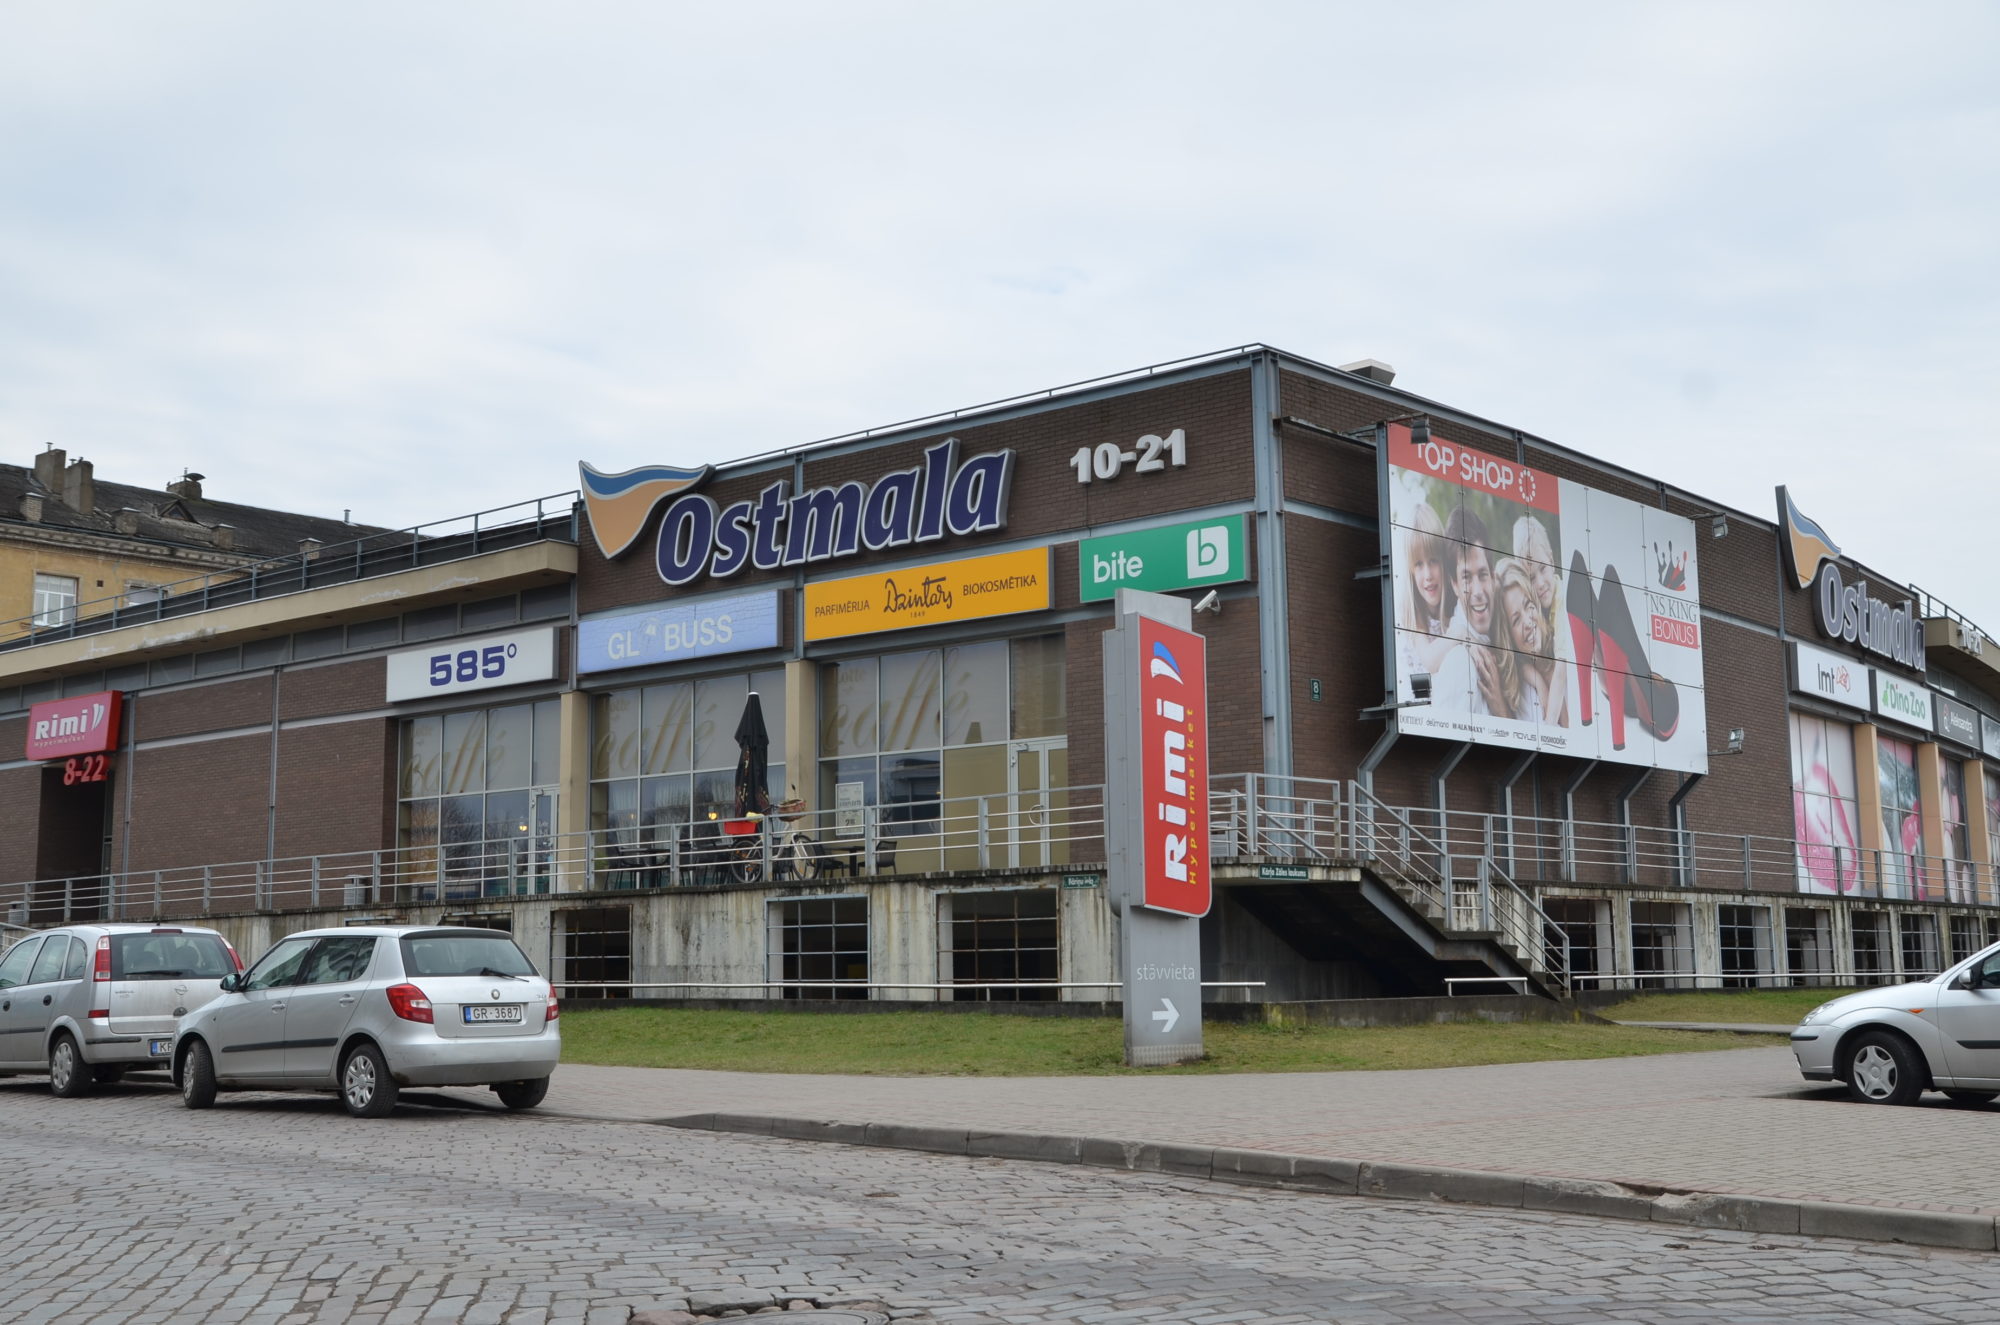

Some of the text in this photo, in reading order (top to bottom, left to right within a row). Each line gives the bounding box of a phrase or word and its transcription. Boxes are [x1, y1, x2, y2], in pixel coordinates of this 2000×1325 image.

[1070, 428, 1187, 484] 10-21
[1417, 441, 1514, 490] TOP SHOP
[656, 437, 1015, 586] Ostmala
[1093, 550, 1144, 584] bite
[814, 574, 1038, 618] PARFIMĒRIJA Dzintars BIOKOSMĒTIKA
[1668, 601, 1698, 623] KING
[910, 610, 926, 619] 1849
[1654, 618, 1695, 645] BONUS
[1820, 563, 1926, 673] Ostmala
[1313, 681, 1319, 693] 8
[34, 708, 88, 740] Rimi
[63, 754, 107, 786] 8-22
[1156, 697, 1188, 883] Rimi
[1186, 708, 1199, 885] Hypermarket
[1136, 963, 1195, 980] stāvvieta
